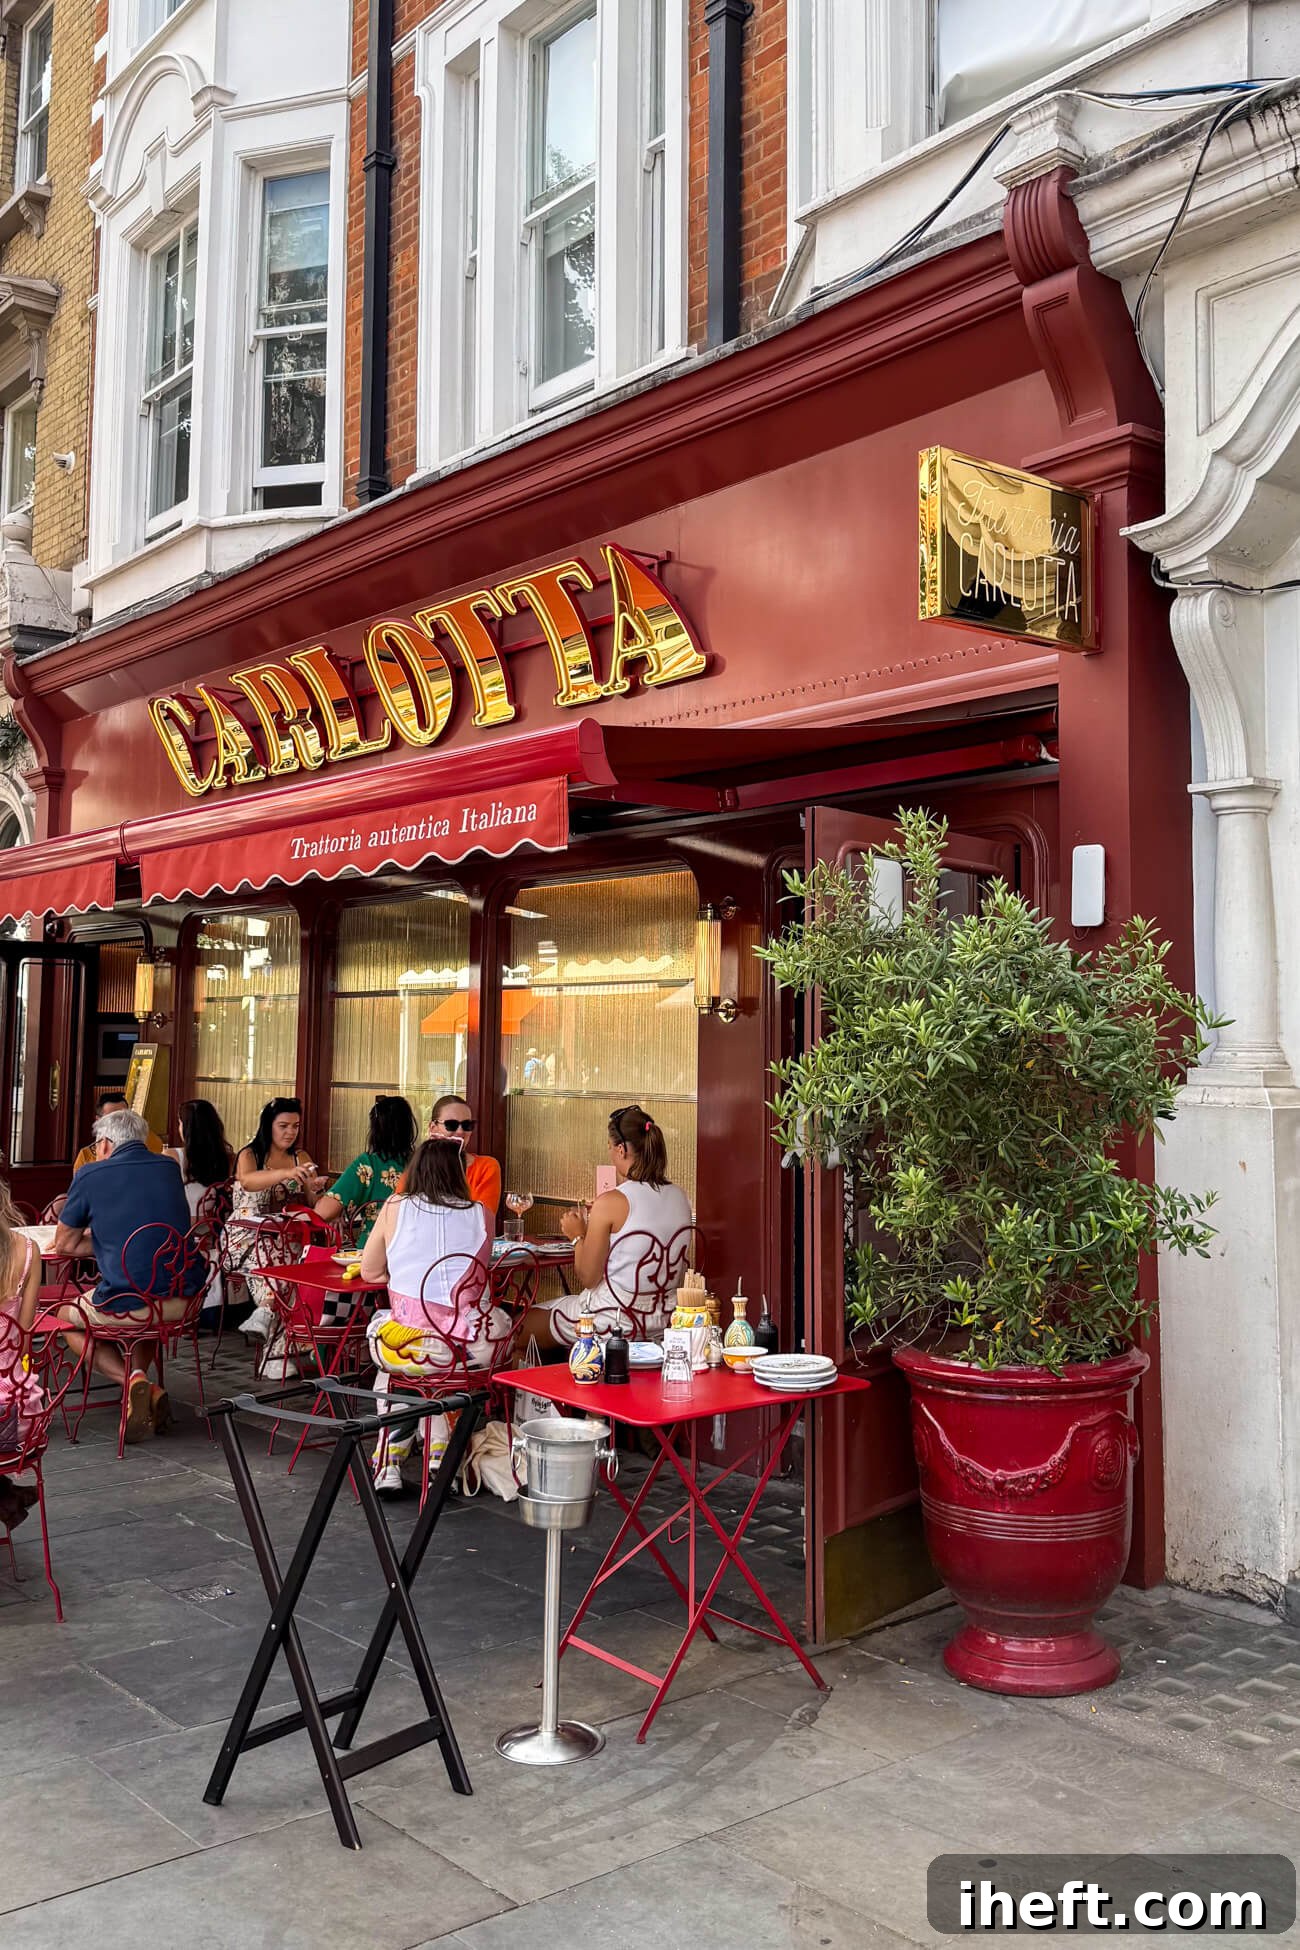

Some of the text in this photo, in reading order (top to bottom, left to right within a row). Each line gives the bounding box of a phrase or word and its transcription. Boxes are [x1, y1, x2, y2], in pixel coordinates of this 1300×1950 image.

[957, 479, 1081, 555] Trattoria
[958, 532, 1079, 624] CARLOTTA
[148, 542, 709, 797] CARLOTTA
[290, 801, 537, 860] Trattoria autentica Italiana
